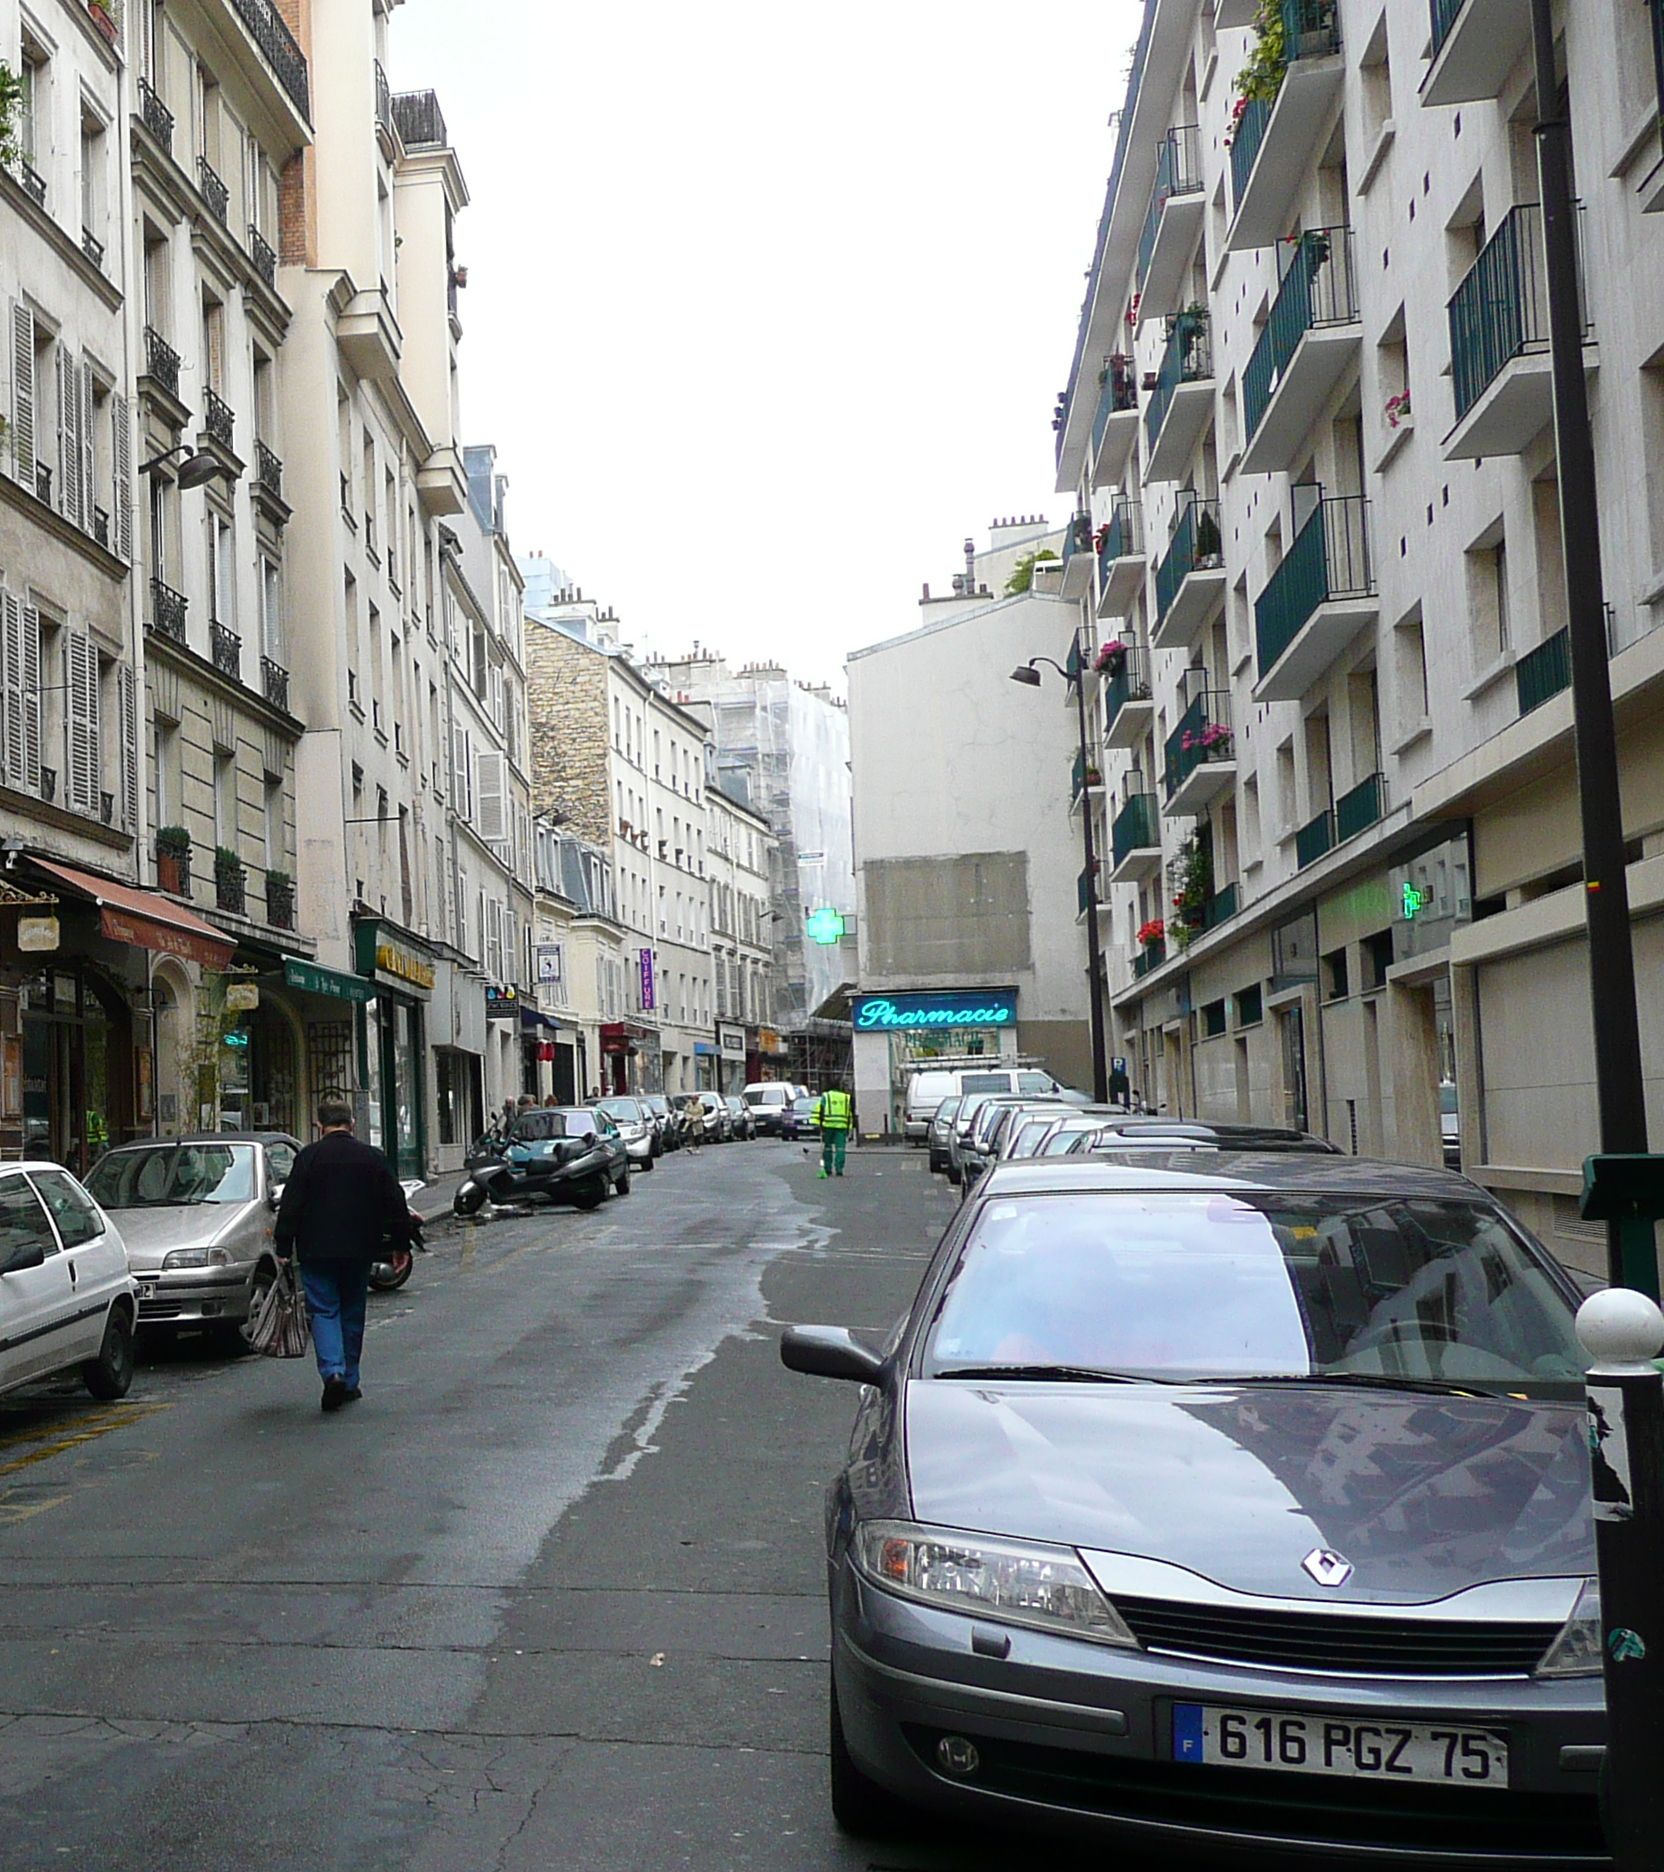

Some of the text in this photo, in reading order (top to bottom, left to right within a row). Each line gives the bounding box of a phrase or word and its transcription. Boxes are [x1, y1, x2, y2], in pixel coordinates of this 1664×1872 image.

[641, 949, 652, 1009] COIFFURE
[858, 1000, 1010, 1026] Pharmacie
[1183, 1739, 1193, 1753] F
[1219, 1713, 1489, 1780] 616 PGZ 75
